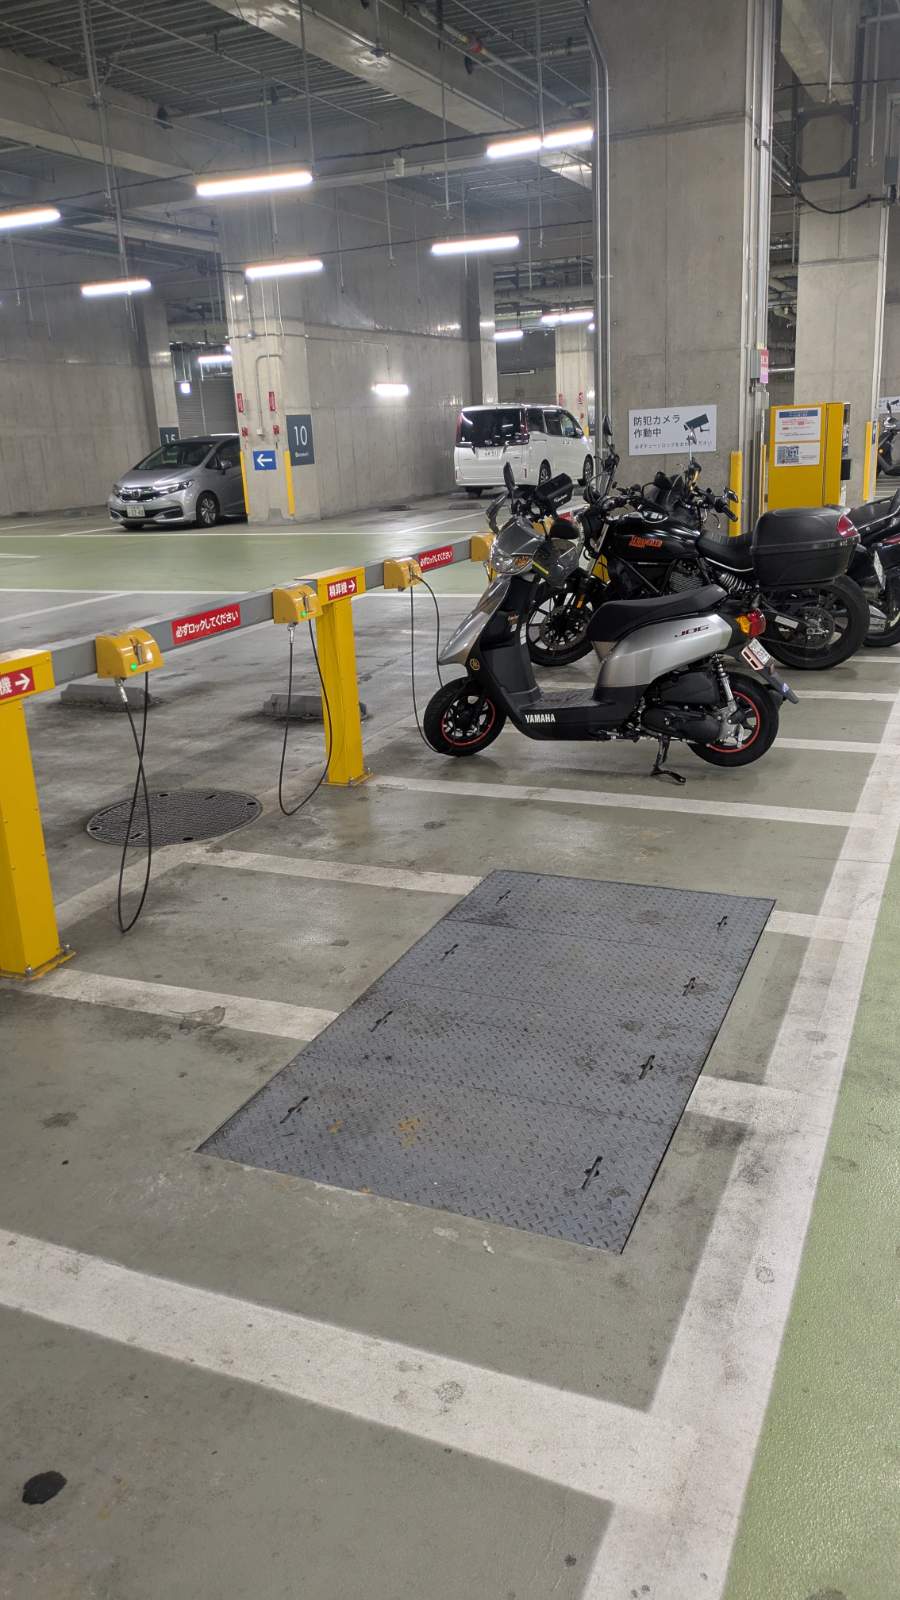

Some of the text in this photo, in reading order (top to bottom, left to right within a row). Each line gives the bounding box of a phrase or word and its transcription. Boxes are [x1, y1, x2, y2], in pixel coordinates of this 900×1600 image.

[633, 414, 680, 426] 防犯カメラ
[294, 425, 307, 446] 10
[633, 428, 661, 438] 作動中
[176, 610, 239, 638] 必ずロックしてください
[525, 713, 556, 723] YAMAHA
